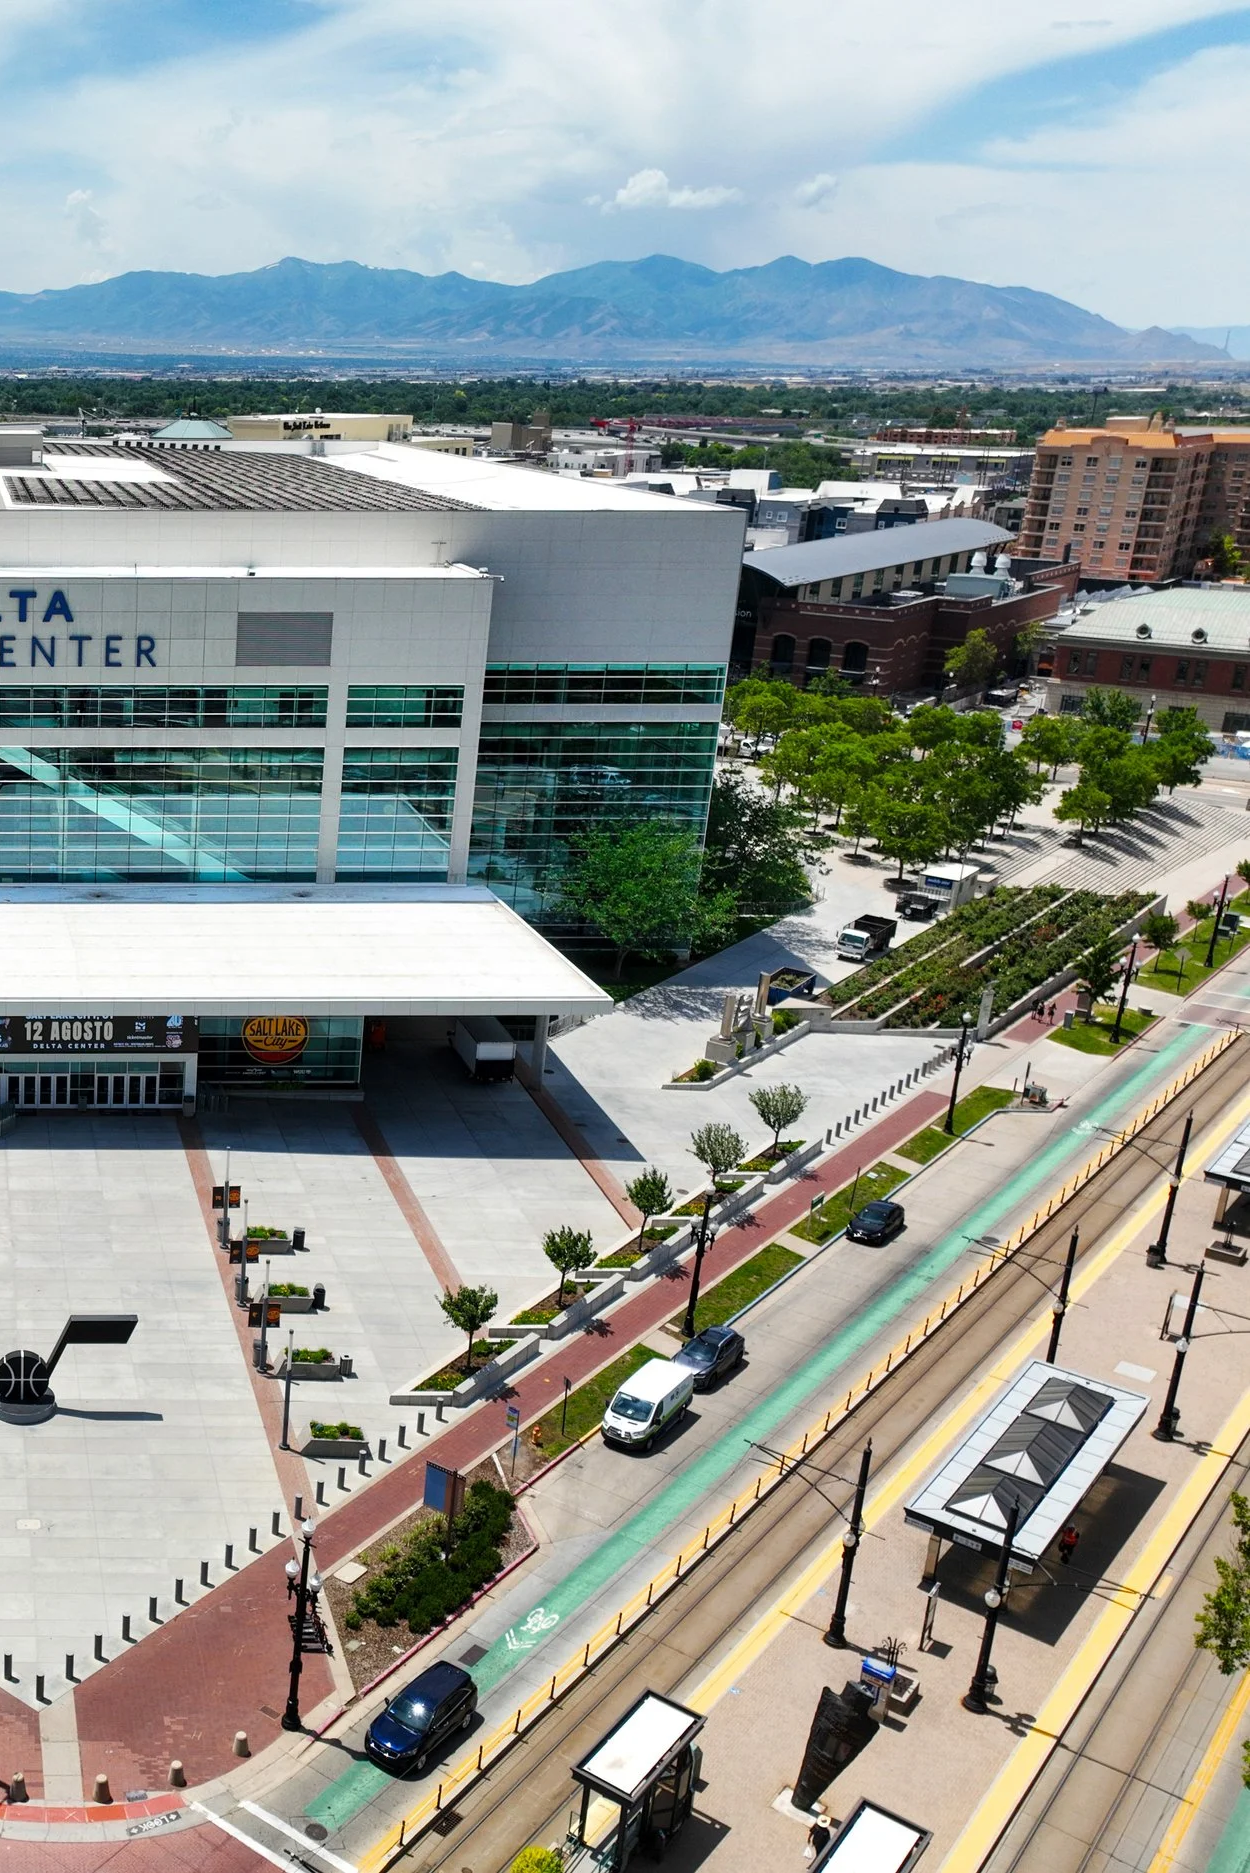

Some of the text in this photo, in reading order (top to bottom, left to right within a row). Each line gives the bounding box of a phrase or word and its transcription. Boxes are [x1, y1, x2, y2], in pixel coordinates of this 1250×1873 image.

[24, 1021, 114, 1041] 12 AGOSTO
[249, 1018, 301, 1036] SALT LAKE
[263, 1036, 288, 1049] City
[139, 1815, 170, 1832] LOOK
